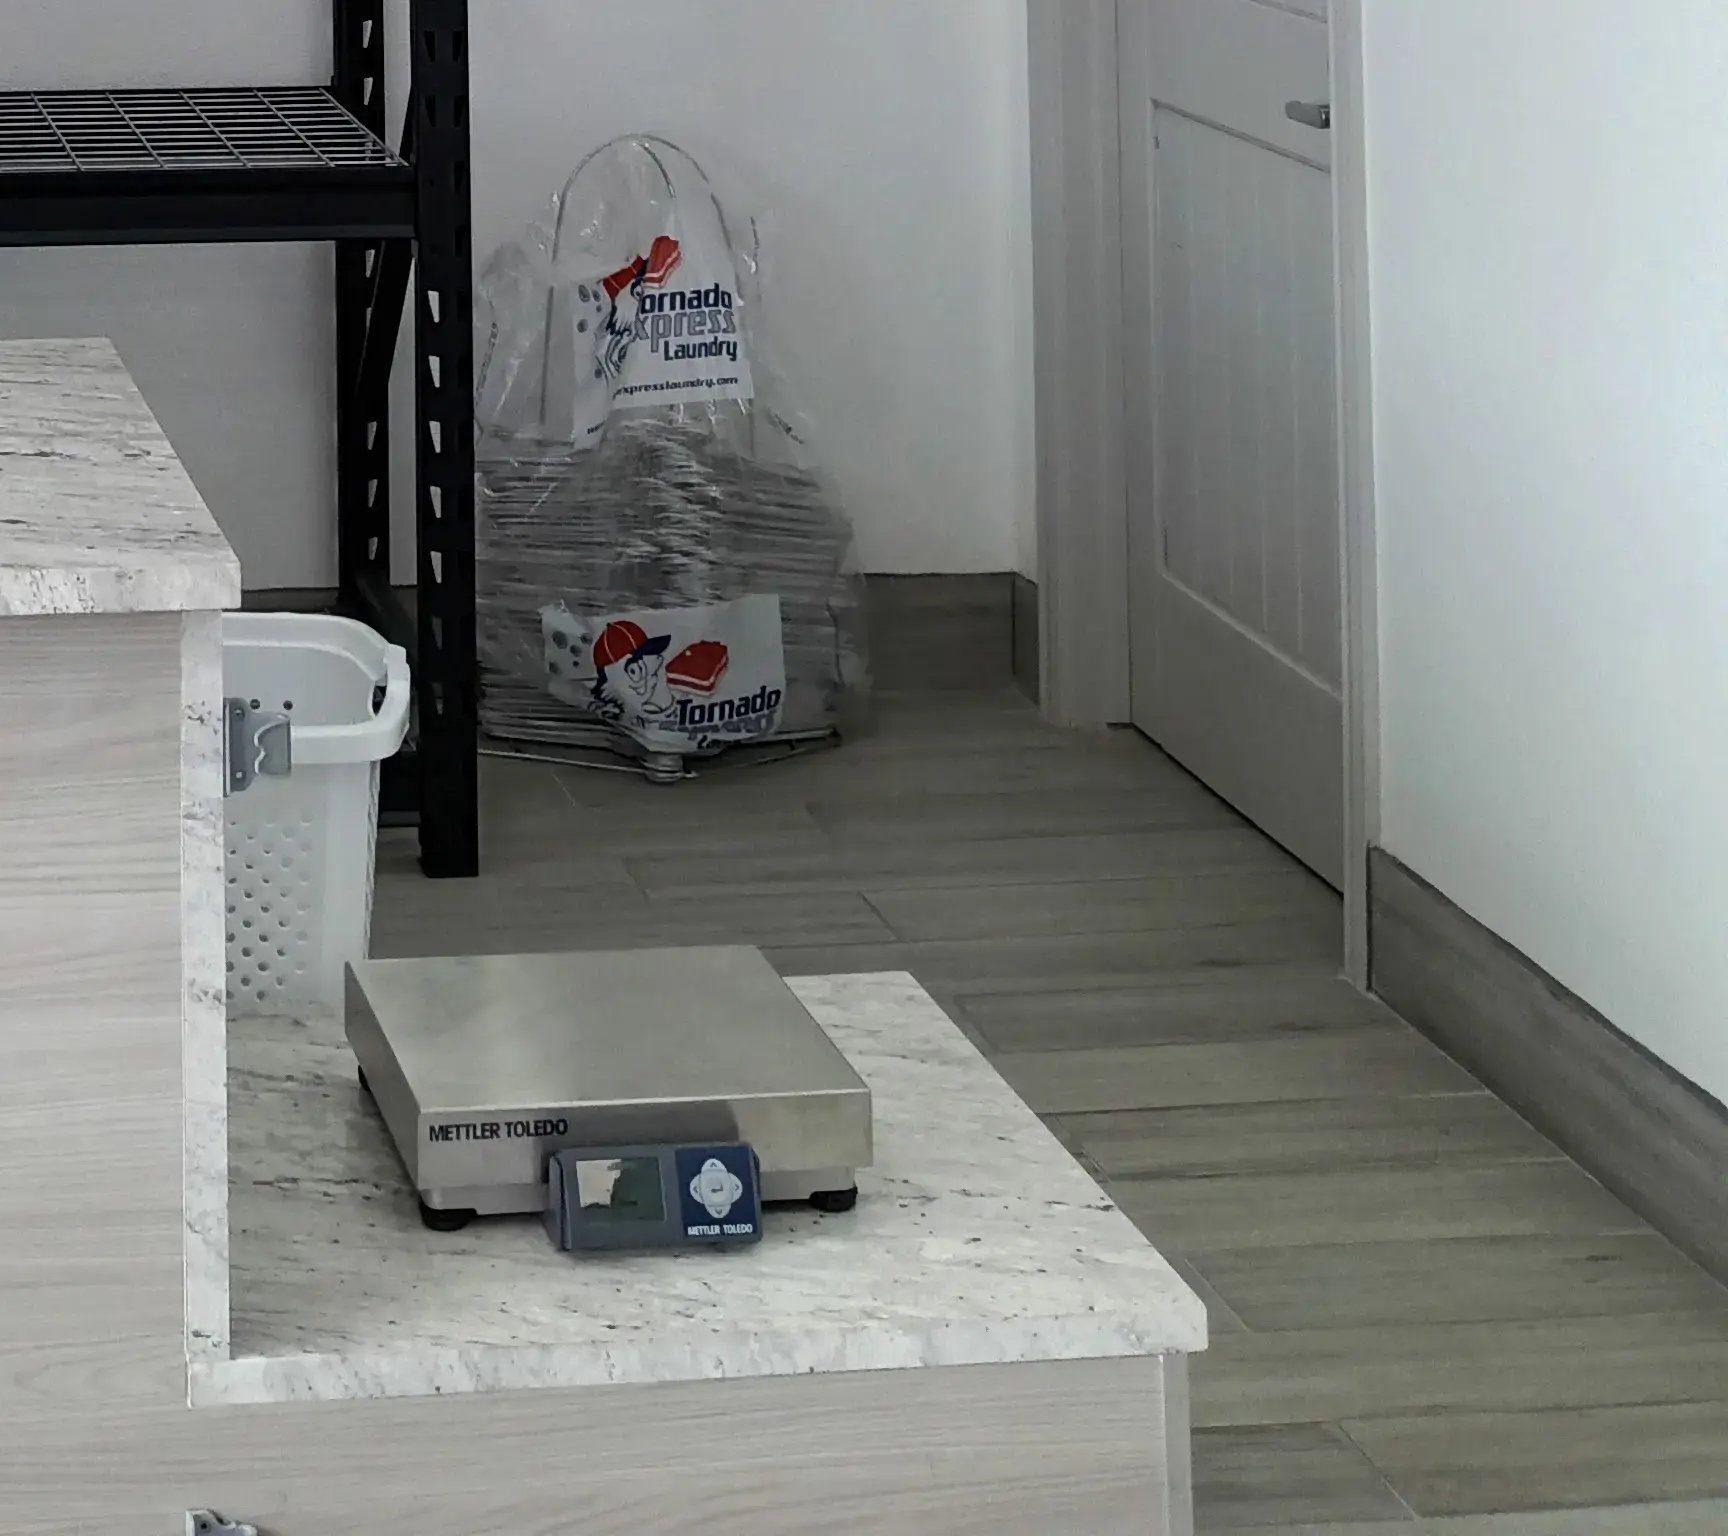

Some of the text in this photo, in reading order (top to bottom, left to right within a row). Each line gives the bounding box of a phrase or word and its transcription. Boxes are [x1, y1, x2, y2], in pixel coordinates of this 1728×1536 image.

[663, 336, 738, 362] Laundry
[676, 685, 782, 727] Tornado
[428, 1119, 569, 1142] METTLER TOLEDO
[687, 1223, 753, 1236] METTLER TOLEDO
